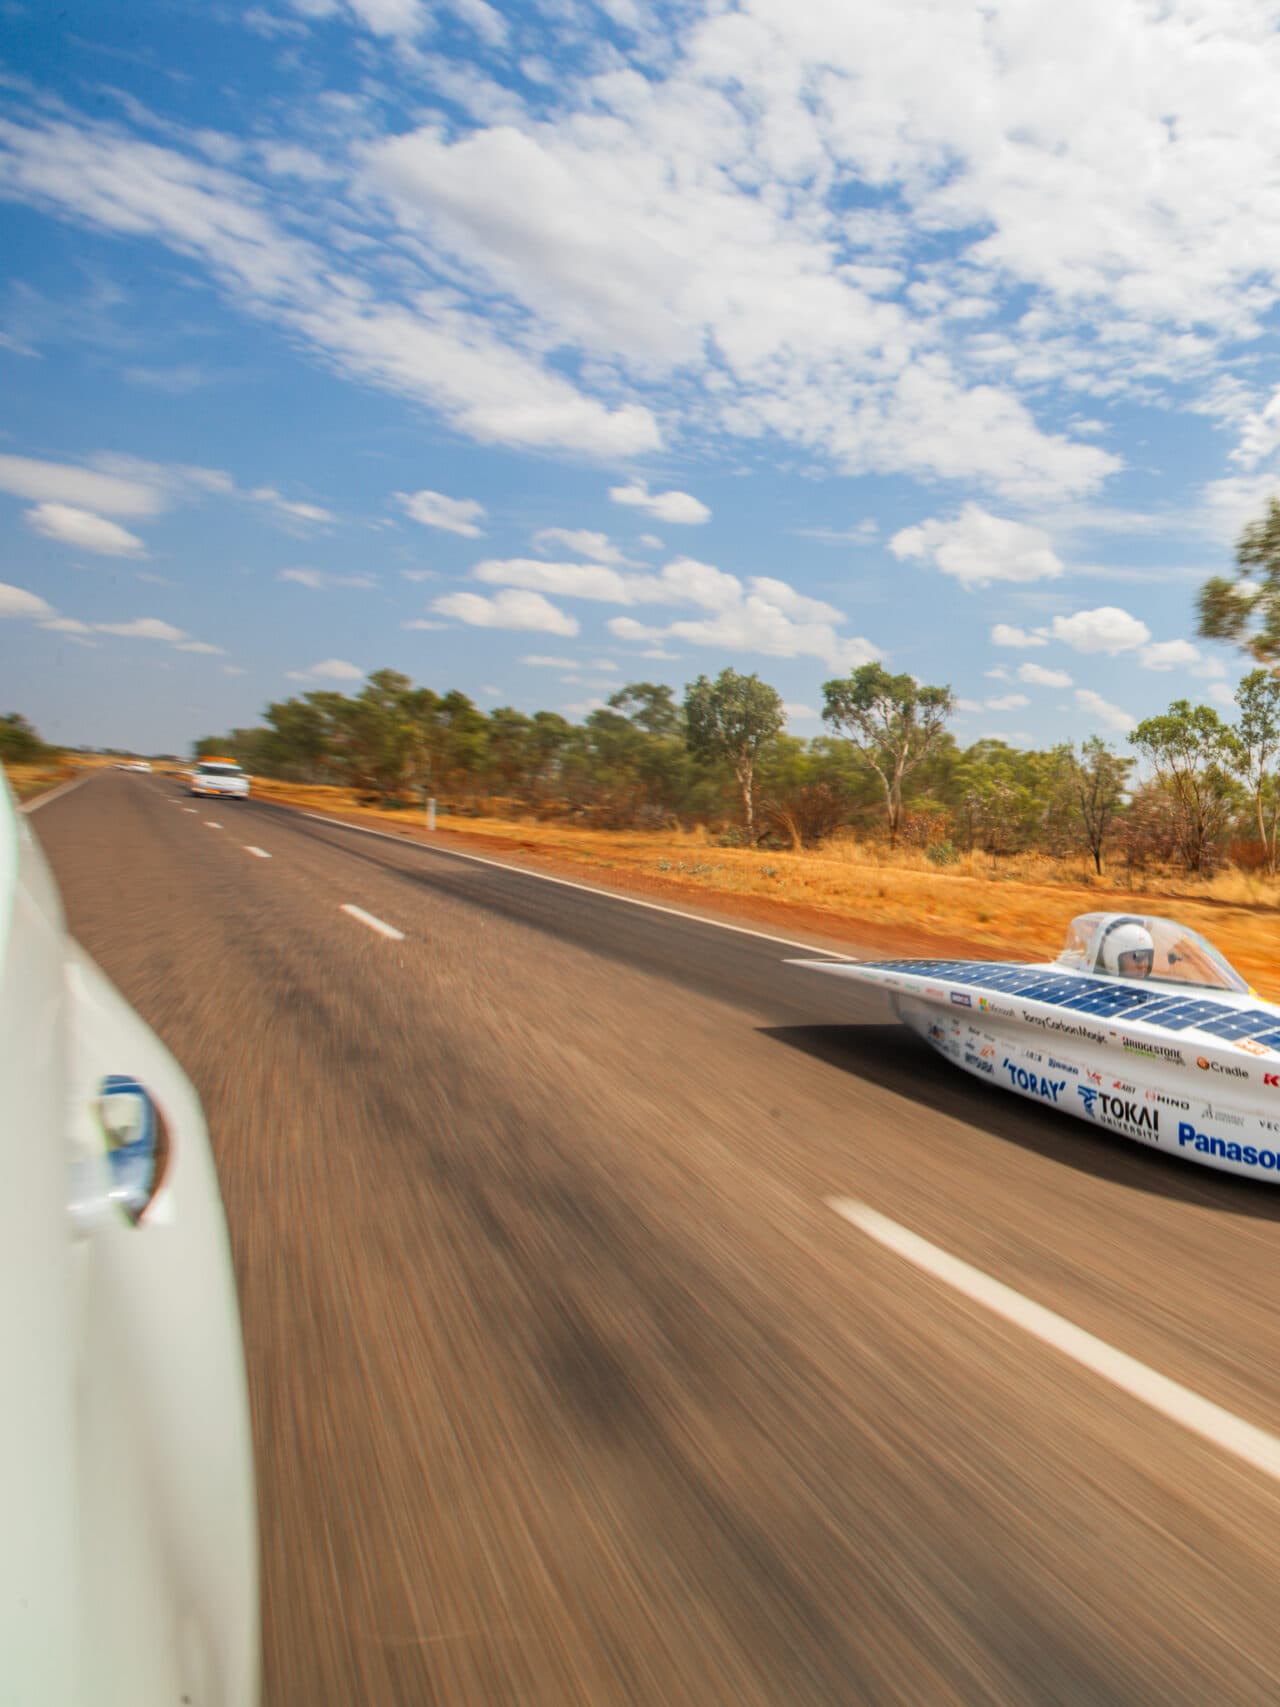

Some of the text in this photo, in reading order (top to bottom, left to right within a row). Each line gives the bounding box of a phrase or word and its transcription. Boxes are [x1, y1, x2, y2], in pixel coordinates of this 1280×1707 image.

[1122, 1035, 1182, 1059] BRIDGESTONE
[1210, 1061, 1249, 1079] Cradle
[1098, 1092, 1159, 1132] TOKAI
[1157, 1094, 1190, 1110] HINO
[1101, 1114, 1160, 1142] UNIVERSITY
